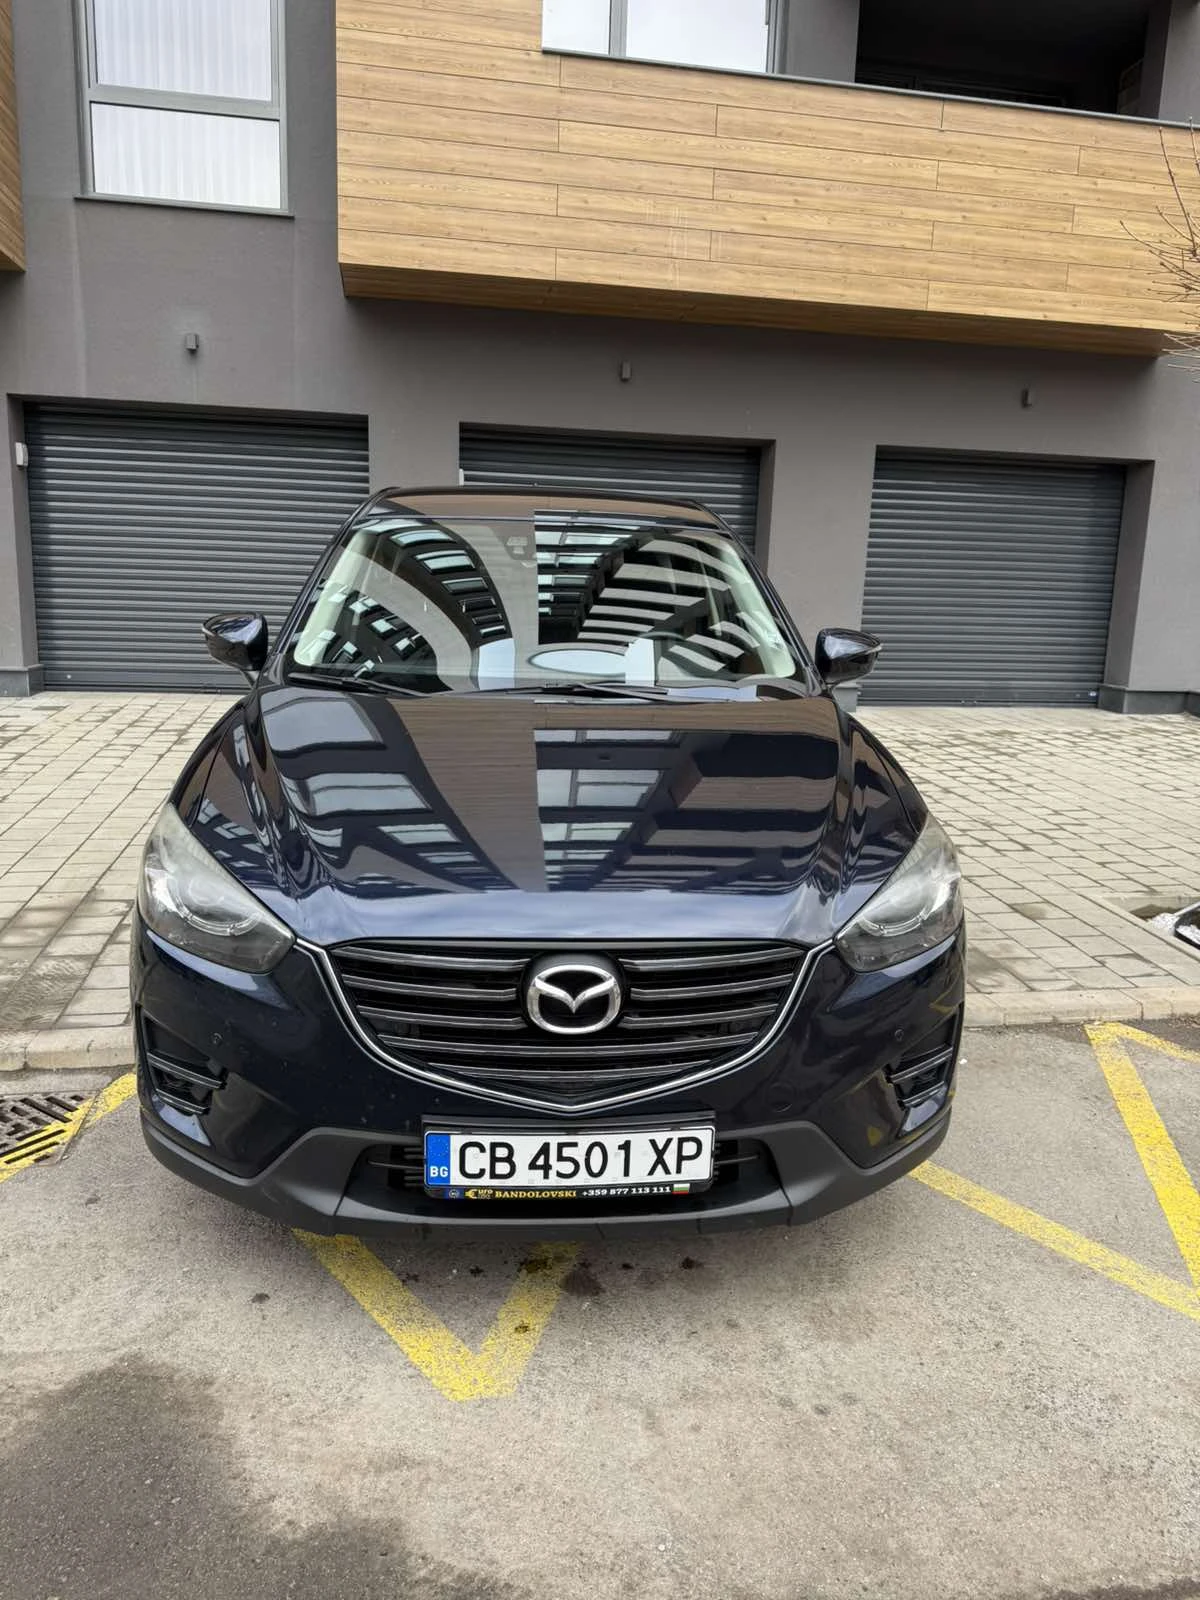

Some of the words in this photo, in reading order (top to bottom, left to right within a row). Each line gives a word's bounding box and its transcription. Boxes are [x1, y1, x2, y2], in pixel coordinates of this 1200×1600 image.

[459, 1141, 517, 1180] CB
[528, 1140, 632, 1180] 4501
[647, 1136, 703, 1177] XP
[429, 1166, 449, 1178] BG
[495, 1190, 577, 1199] BANDOLOVSKI
[582, 1188, 608, 1197] +359
[609, 1187, 629, 1196] 877
[631, 1186, 650, 1195] 113
[652, 1185, 672, 1194] 111
